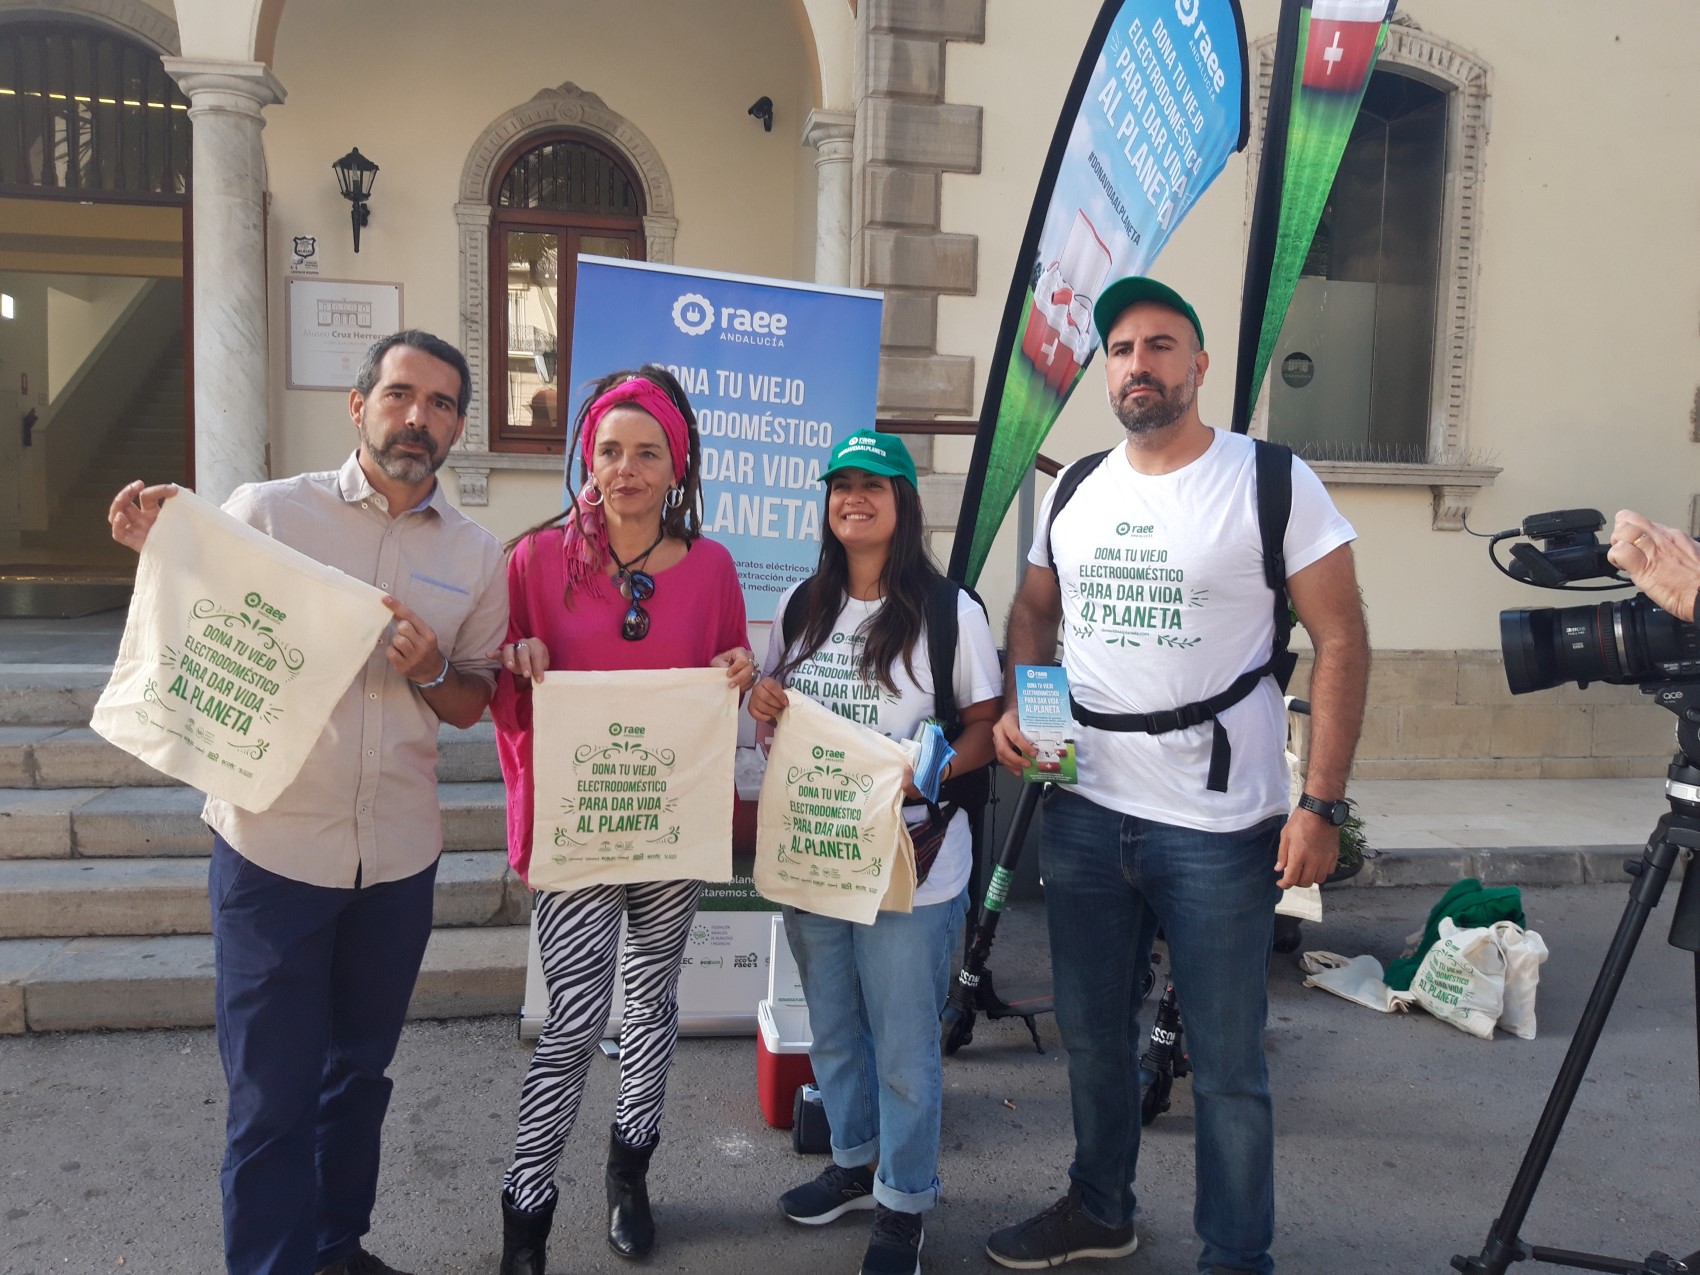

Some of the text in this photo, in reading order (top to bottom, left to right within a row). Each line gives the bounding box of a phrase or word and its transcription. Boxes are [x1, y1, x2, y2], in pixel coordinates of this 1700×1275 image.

[1194, 20, 1225, 93] raee
[1152, 17, 1204, 135] DONA TU VIEJO
[1128, 18, 1204, 176] ELECTRODOMÉSTICO
[1116, 46, 1188, 198] PARA DAR VIDA
[1098, 76, 1175, 231] AL PLANETA
[1087, 150, 1142, 246] #DONAVIDAALPLANETA
[721, 307, 788, 335] raee
[331, 330, 352, 338] Cruz
[720, 331, 785, 348] ANDALUCÍA
[716, 369, 743, 399] TU
[749, 373, 805, 406] VIEJO
[692, 409, 833, 449] ODOMÉSTICO
[702, 447, 822, 492] DAR VIDA
[688, 490, 821, 542] LANETA
[1132, 524, 1154, 533] raee
[1094, 547, 1168, 563] DONA TU VIEJO
[734, 561, 817, 574] aratos eléctricos y
[738, 571, 784, 581] extracción
[786, 574, 797, 583] de
[1079, 564, 1184, 583] ELECTRODOMÉSTICO
[1080, 582, 1183, 604] PARA DAR VIDA
[261, 602, 287, 621] raee
[1080, 601, 1182, 630] AL PLANETA
[203, 624, 278, 672] DONA TU VIEJO
[184, 634, 280, 696] ELECTRODOMÉSTICO
[836, 653, 849, 666] TU
[180, 653, 264, 713] PARA DAR VIDA
[823, 681, 848, 699] DAR
[852, 684, 880, 701] VIDA
[168, 673, 188, 701] AL
[190, 685, 254, 736] PLANETA
[1663, 691, 1683, 699] ace
[821, 701, 879, 726] ANETA
[1025, 704, 1061, 714] AL PLANETA
[624, 725, 646, 734] raee
[825, 750, 845, 759] raee
[592, 763, 657, 776] DONA TU VIEJO
[577, 779, 667, 792] ELECTRODOMÉSTICO
[798, 785, 857, 802] DONA TU VIEJO
[578, 796, 662, 811] PARA DAR VIDA
[789, 800, 862, 821] ELECTRODOMÉSTICO
[576, 814, 659, 833] AL PLANETA
[793, 817, 858, 839] PARA DAR VIDA
[790, 834, 861, 860] AL PLANETA
[700, 887, 747, 897] staremos
[1418, 978, 1459, 1007] AL PLANETA
[1448, 984, 1464, 995] VIDA
